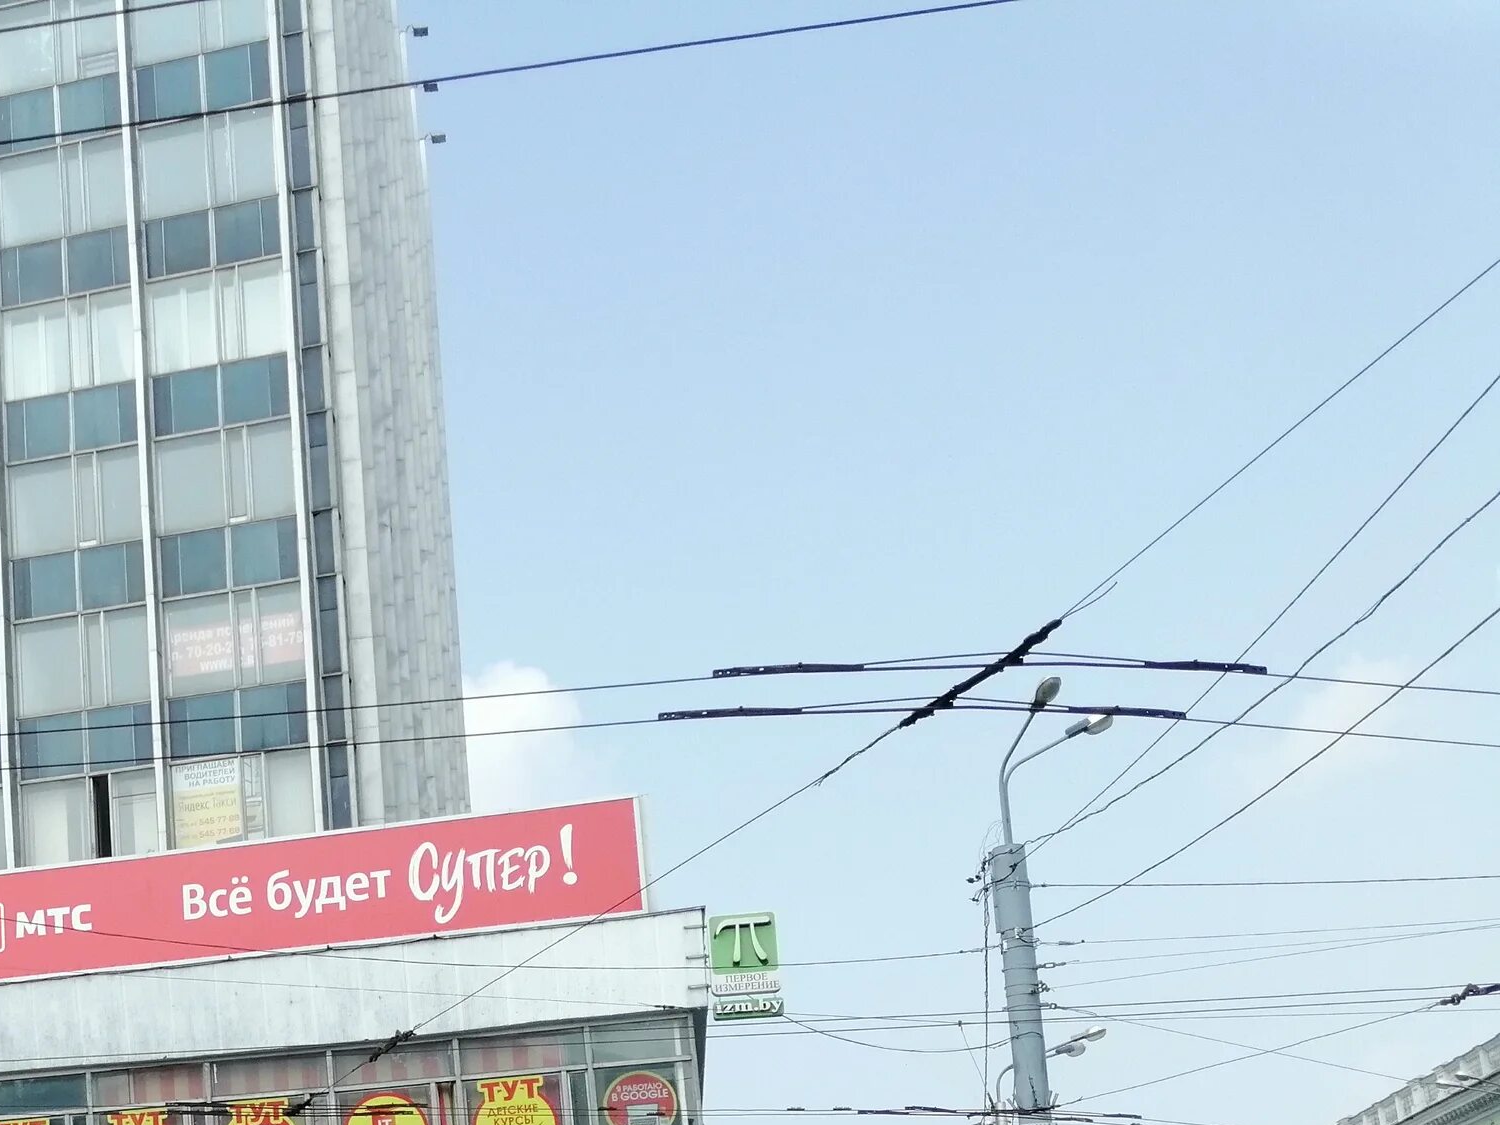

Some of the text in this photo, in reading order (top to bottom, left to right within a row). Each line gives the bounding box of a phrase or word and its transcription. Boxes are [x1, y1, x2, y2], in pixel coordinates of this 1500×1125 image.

[175, 760, 235, 773] ПРИГЛАШАЕМ
[184, 768, 236, 780] ВОДИТЕЛЕЙ
[203, 775, 236, 786] РАБОТУ
[181, 875, 251, 922] Всё
[266, 869, 392, 923] будет
[15, 903, 93, 940] МТС
[725, 973, 768, 984] ПЕРВОЕ
[715, 980, 780, 993] ИЗМЕРЕНИЕ
[715, 999, 783, 1014] izm.by
[623, 1082, 662, 1092] РАБОТАЮ
[620, 1088, 669, 1101] GOOGLE
[487, 1103, 539, 1118] ДЕТСКИЕ
